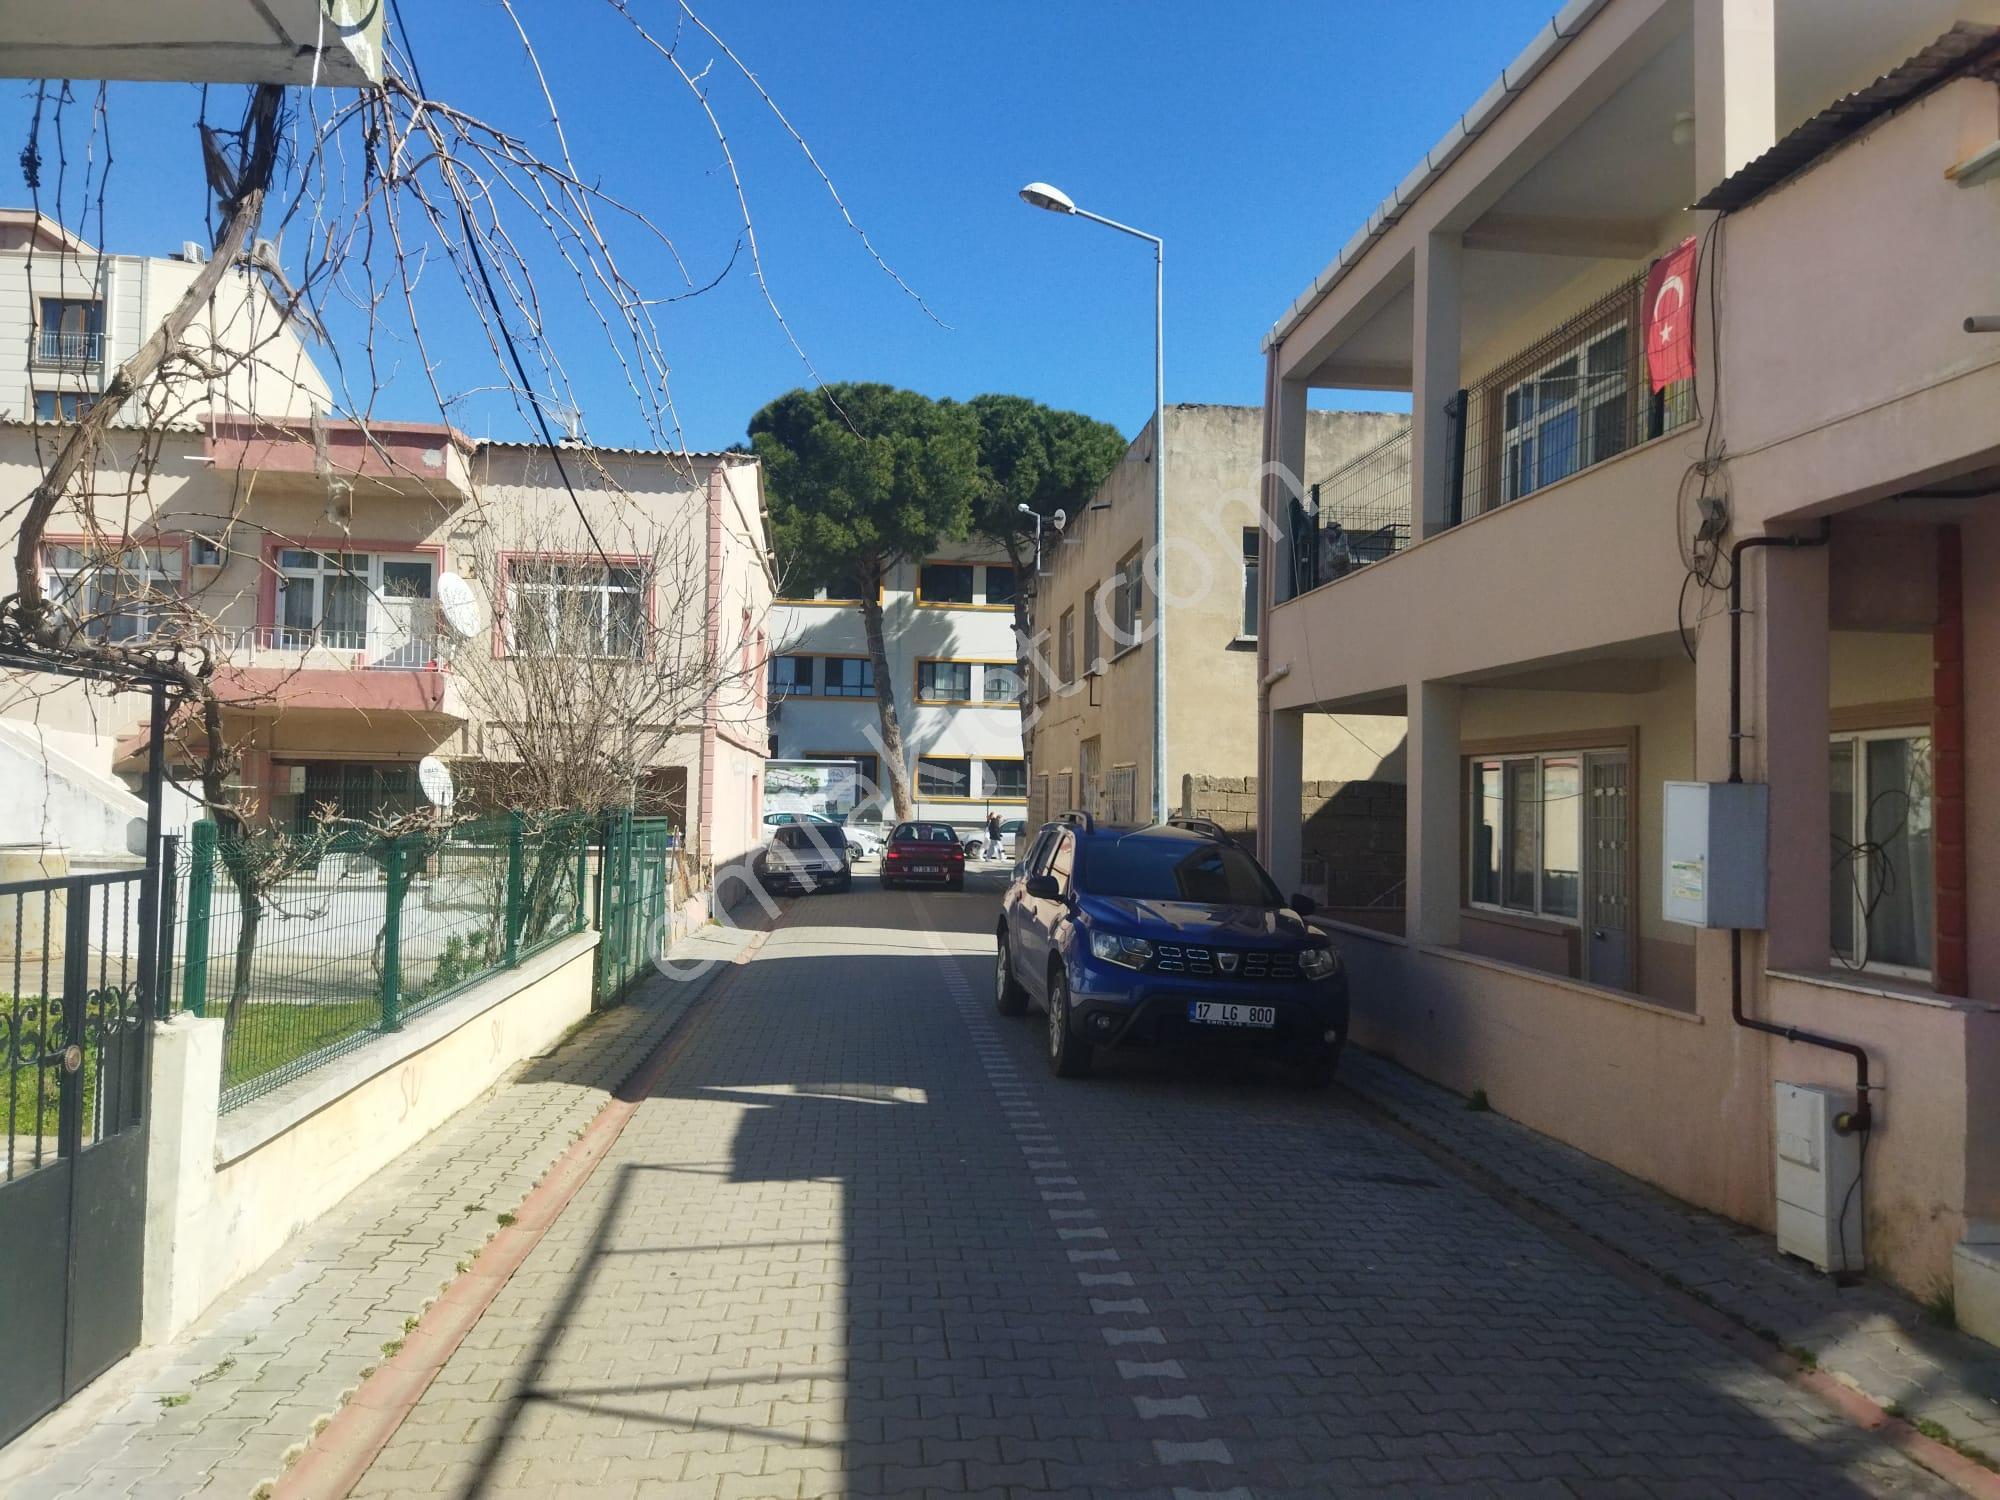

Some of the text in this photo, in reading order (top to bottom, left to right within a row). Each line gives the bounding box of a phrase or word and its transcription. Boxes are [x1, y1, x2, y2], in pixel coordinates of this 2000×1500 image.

[1197, 1003, 1211, 1018] 17
[1222, 1005, 1238, 1020] LG
[1249, 1007, 1272, 1023] 800
